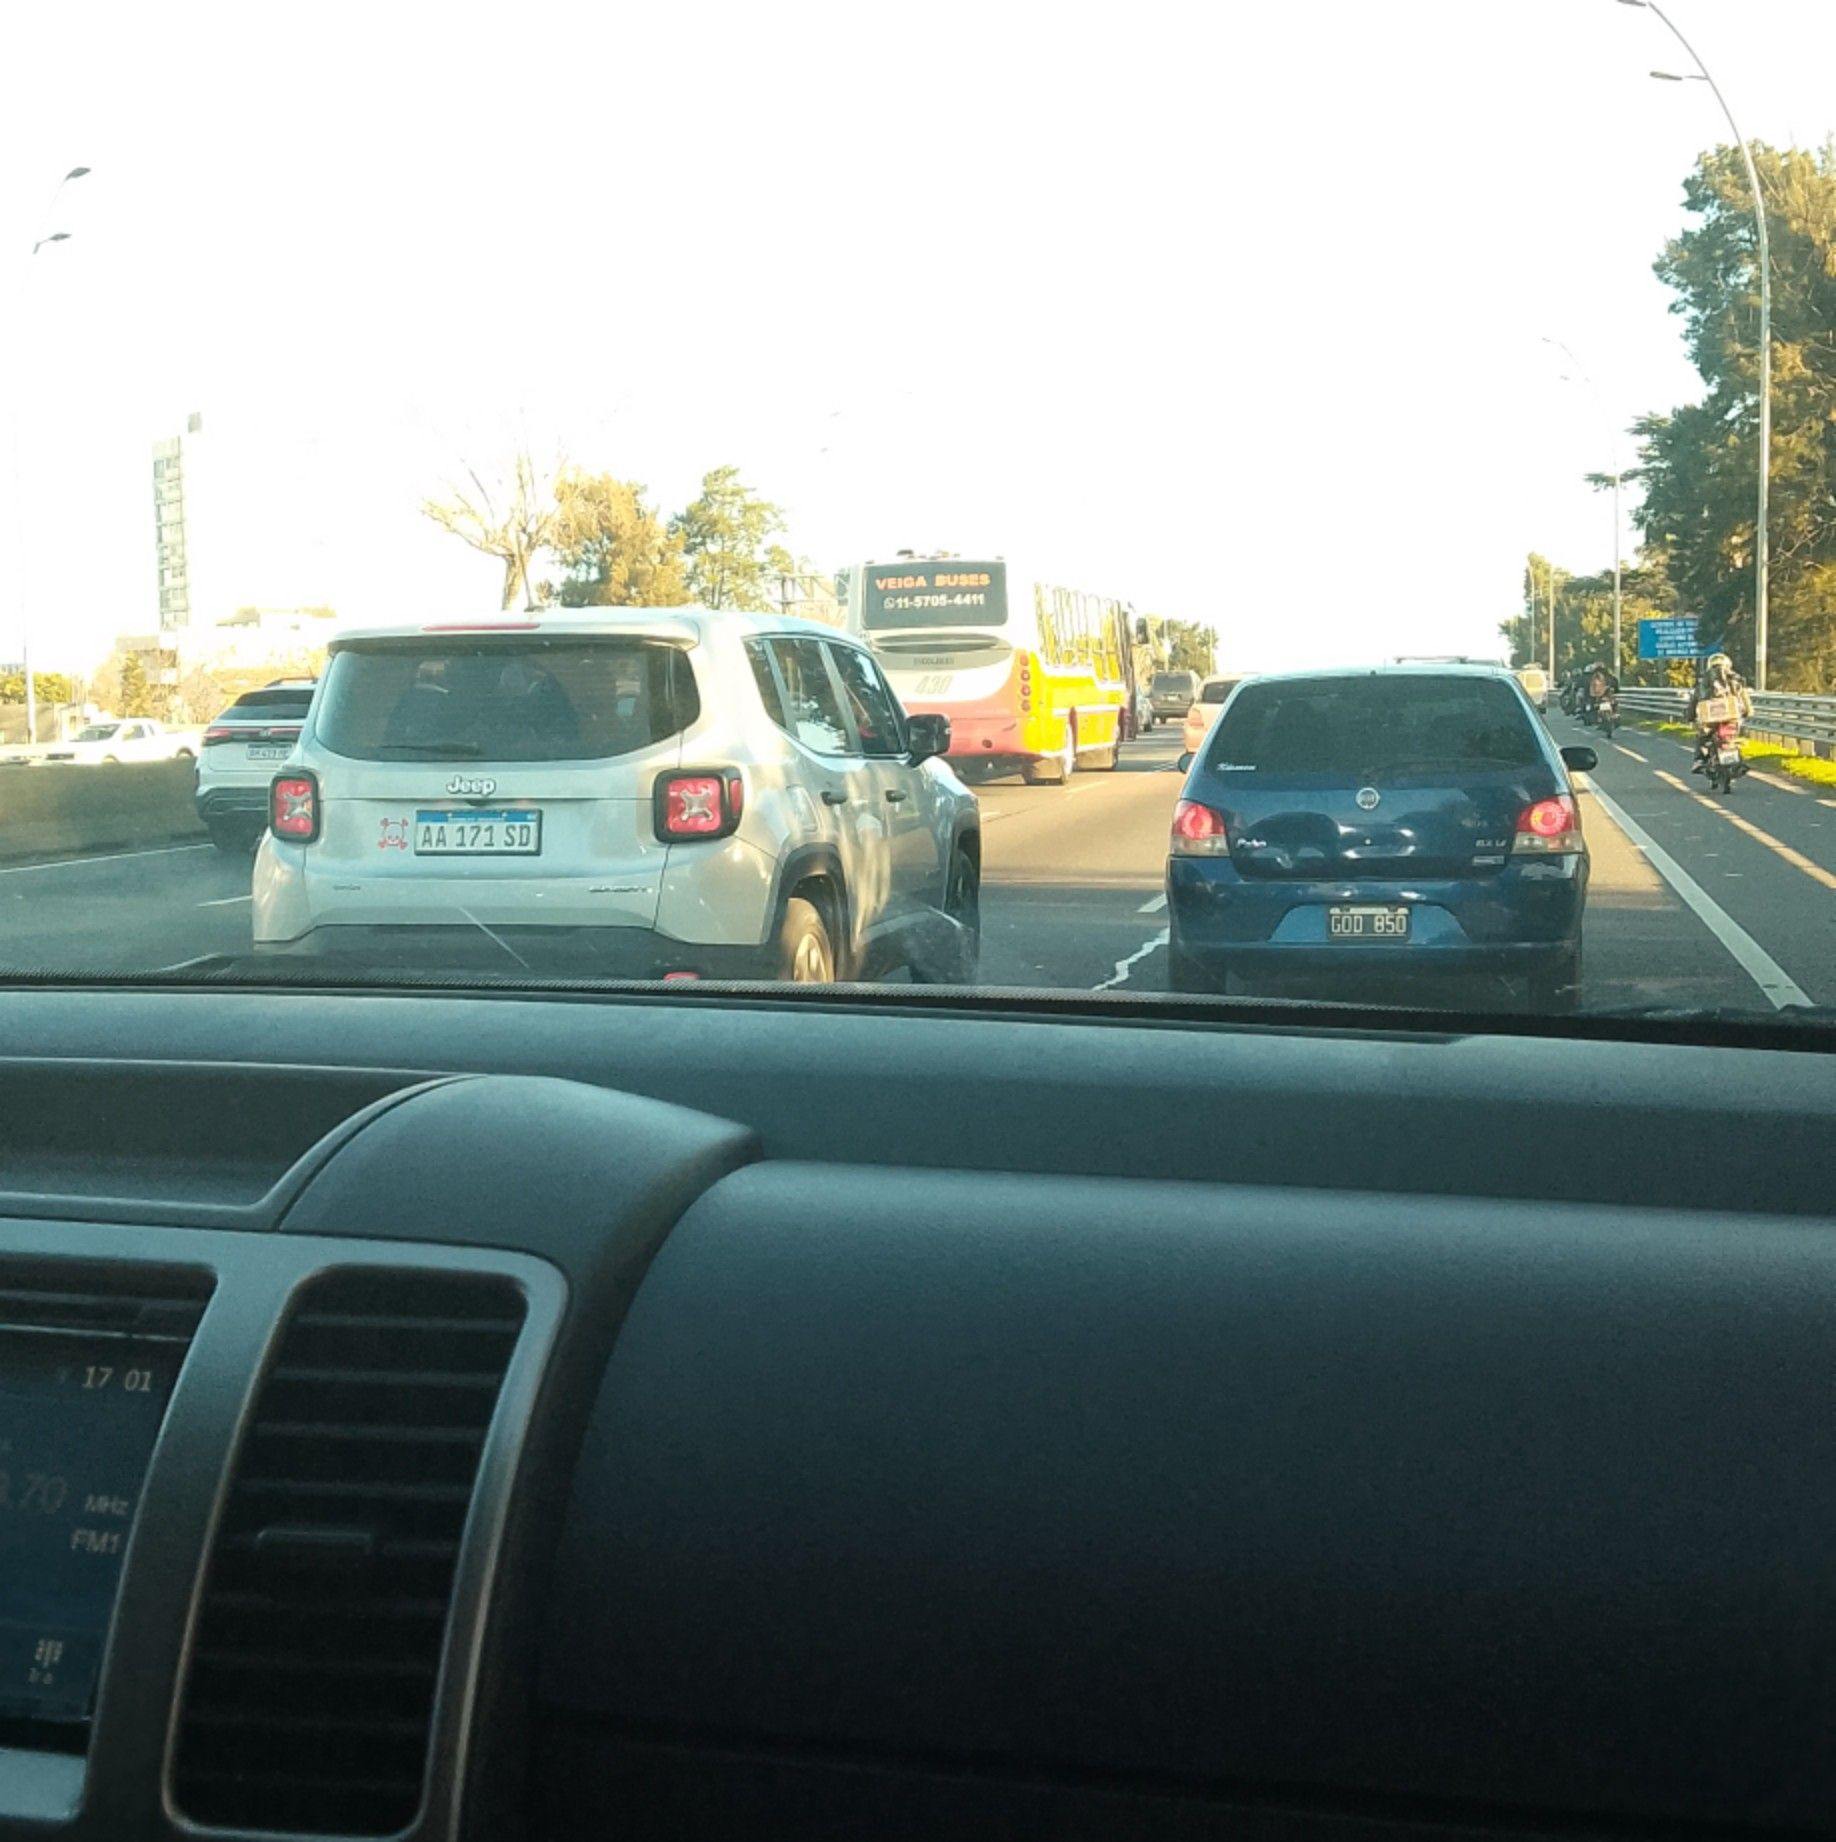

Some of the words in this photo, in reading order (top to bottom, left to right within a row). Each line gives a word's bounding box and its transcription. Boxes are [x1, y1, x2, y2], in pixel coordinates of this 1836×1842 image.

[876, 576, 927, 590] VEIGA
[936, 574, 990, 587] BUSES
[446, 775, 497, 797] Jeep
[421, 825, 447, 848] AA
[455, 825, 495, 847] 171
[503, 824, 531, 847] SD
[1331, 915, 1363, 933] GOD
[1373, 915, 1407, 933] 850
[82, 1365, 113, 1389] 17
[124, 1368, 152, 1392] 01
[70, 1529, 122, 1554] FM1
